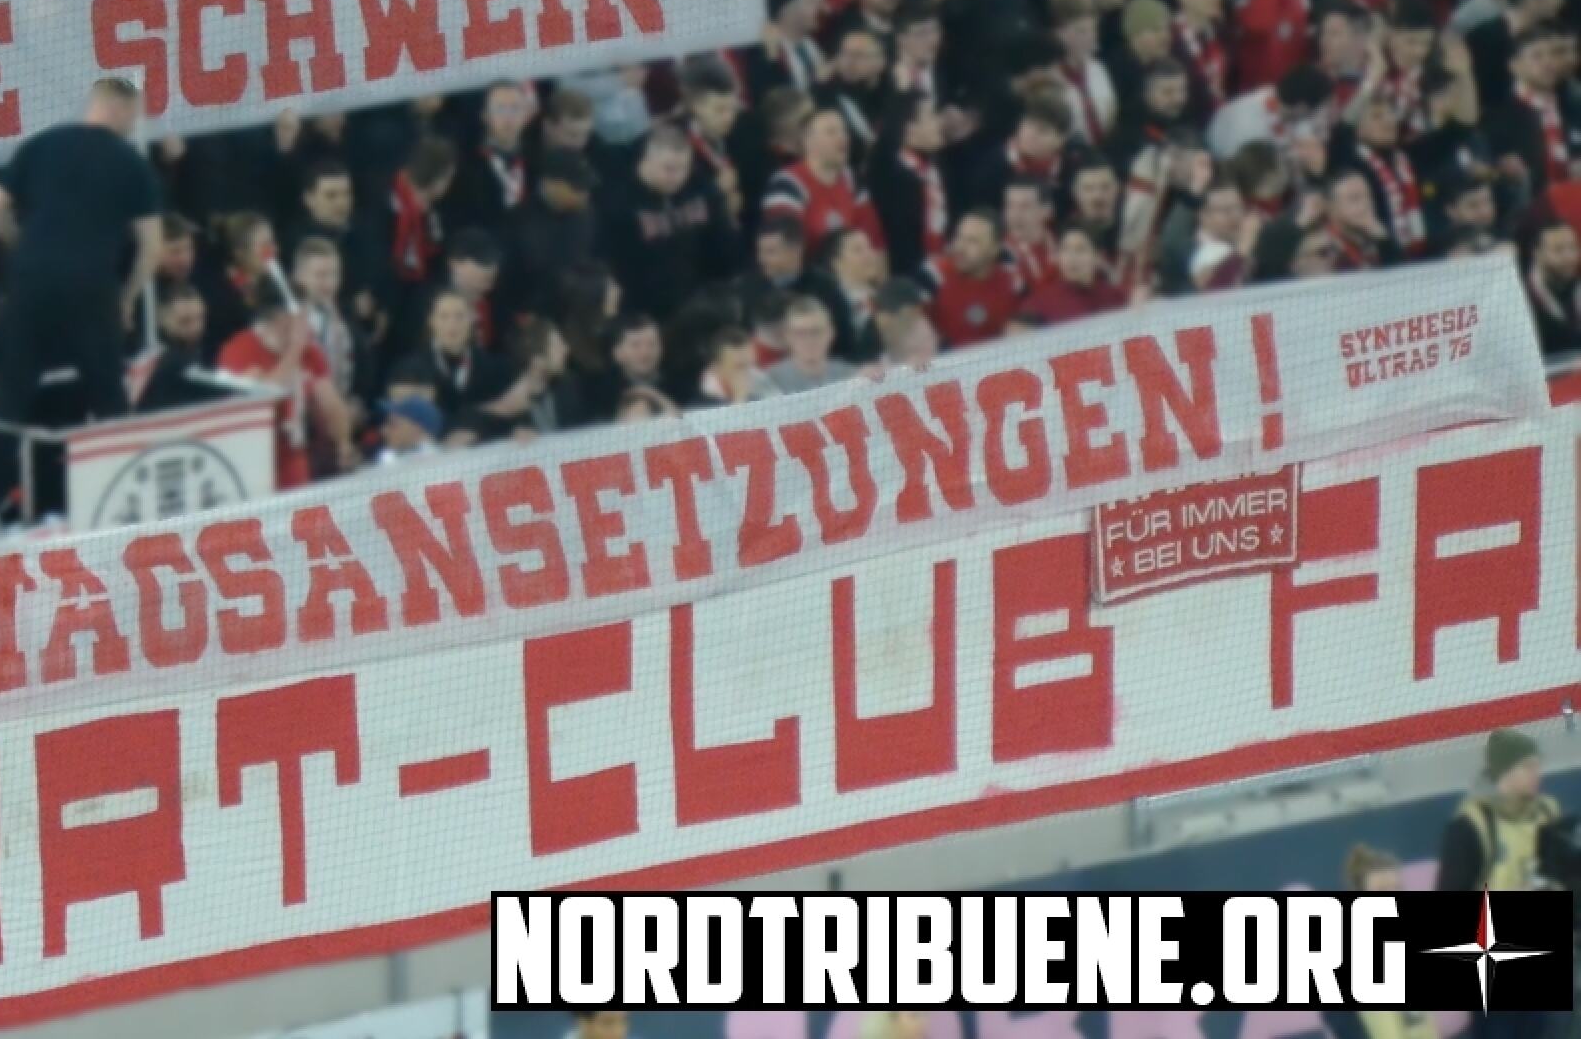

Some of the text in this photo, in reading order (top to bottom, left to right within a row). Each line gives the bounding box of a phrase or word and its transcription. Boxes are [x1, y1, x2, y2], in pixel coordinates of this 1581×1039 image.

[1346, 344, 1440, 389] ULTRAS
[1106, 488, 1288, 549] FÜR IMMER
[1134, 525, 1260, 574] BEI UNS
[1270, 433, 1581, 709] FR
